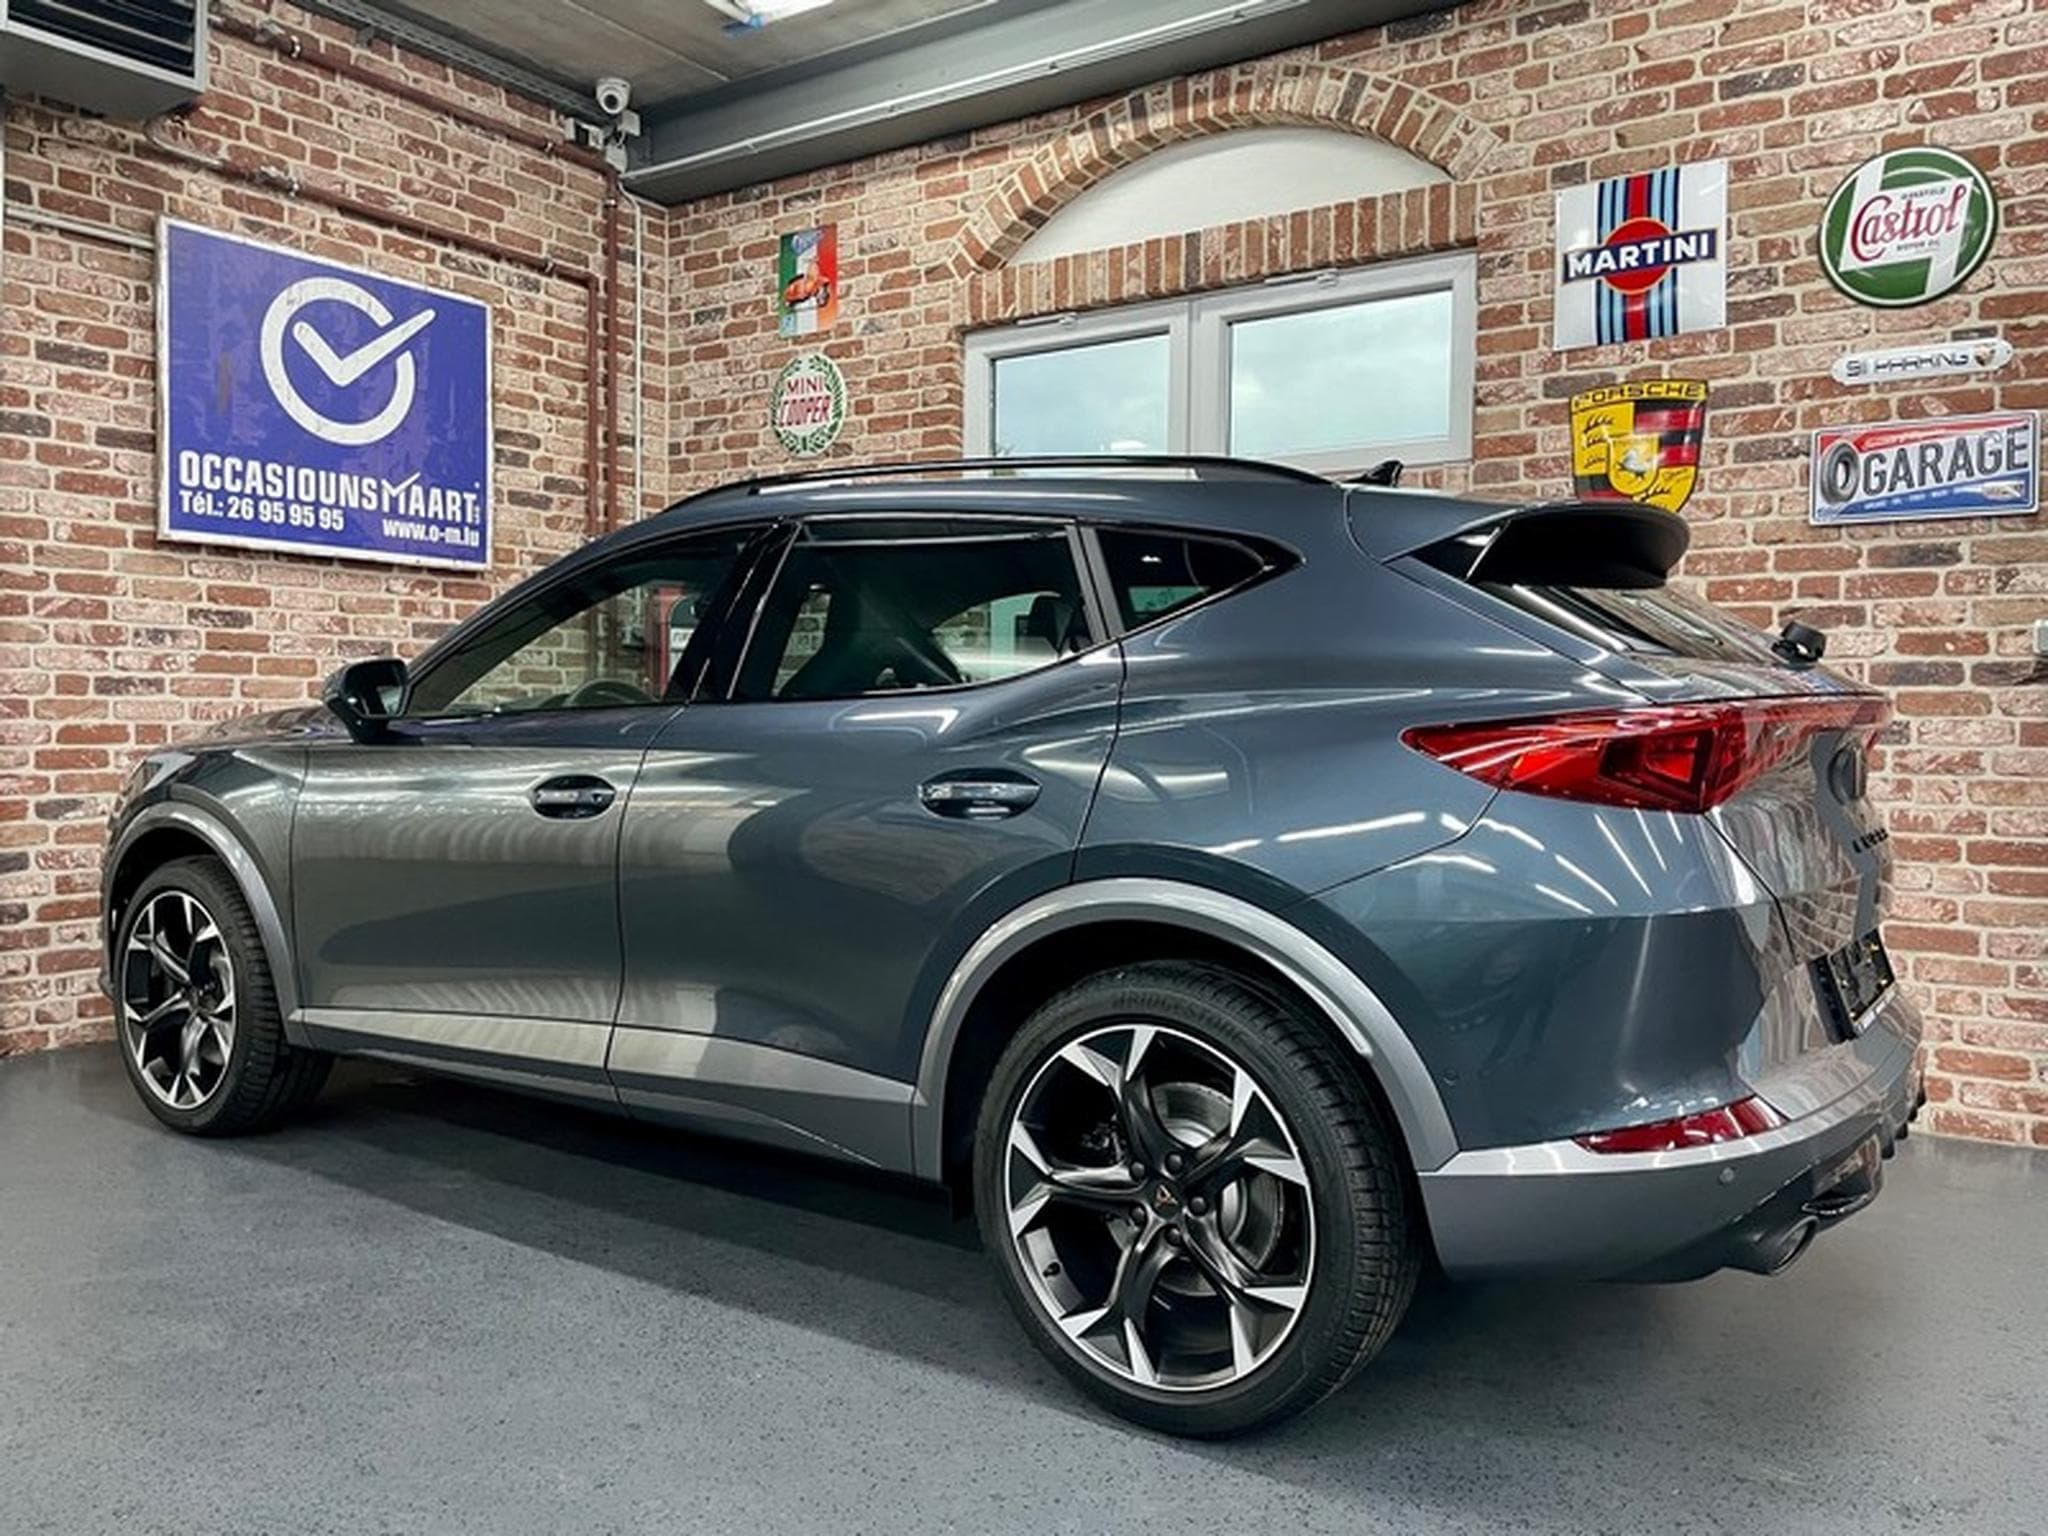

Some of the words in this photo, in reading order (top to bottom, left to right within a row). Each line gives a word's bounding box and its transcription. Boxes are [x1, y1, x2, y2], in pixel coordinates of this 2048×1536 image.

[1850, 184, 1967, 262] Castrol
[1568, 232, 1710, 278] MARTINI
[786, 376, 823, 396] MINI
[1573, 383, 1701, 408] PORSCHE
[780, 395, 831, 427] COOPER
[179, 449, 477, 524] OCCASIOUNSMAART
[227, 495, 255, 521] 26
[258, 499, 286, 524] 95
[289, 503, 316, 528] 95
[319, 507, 345, 532] 95
[382, 518, 480, 547] www.o-m.lu
